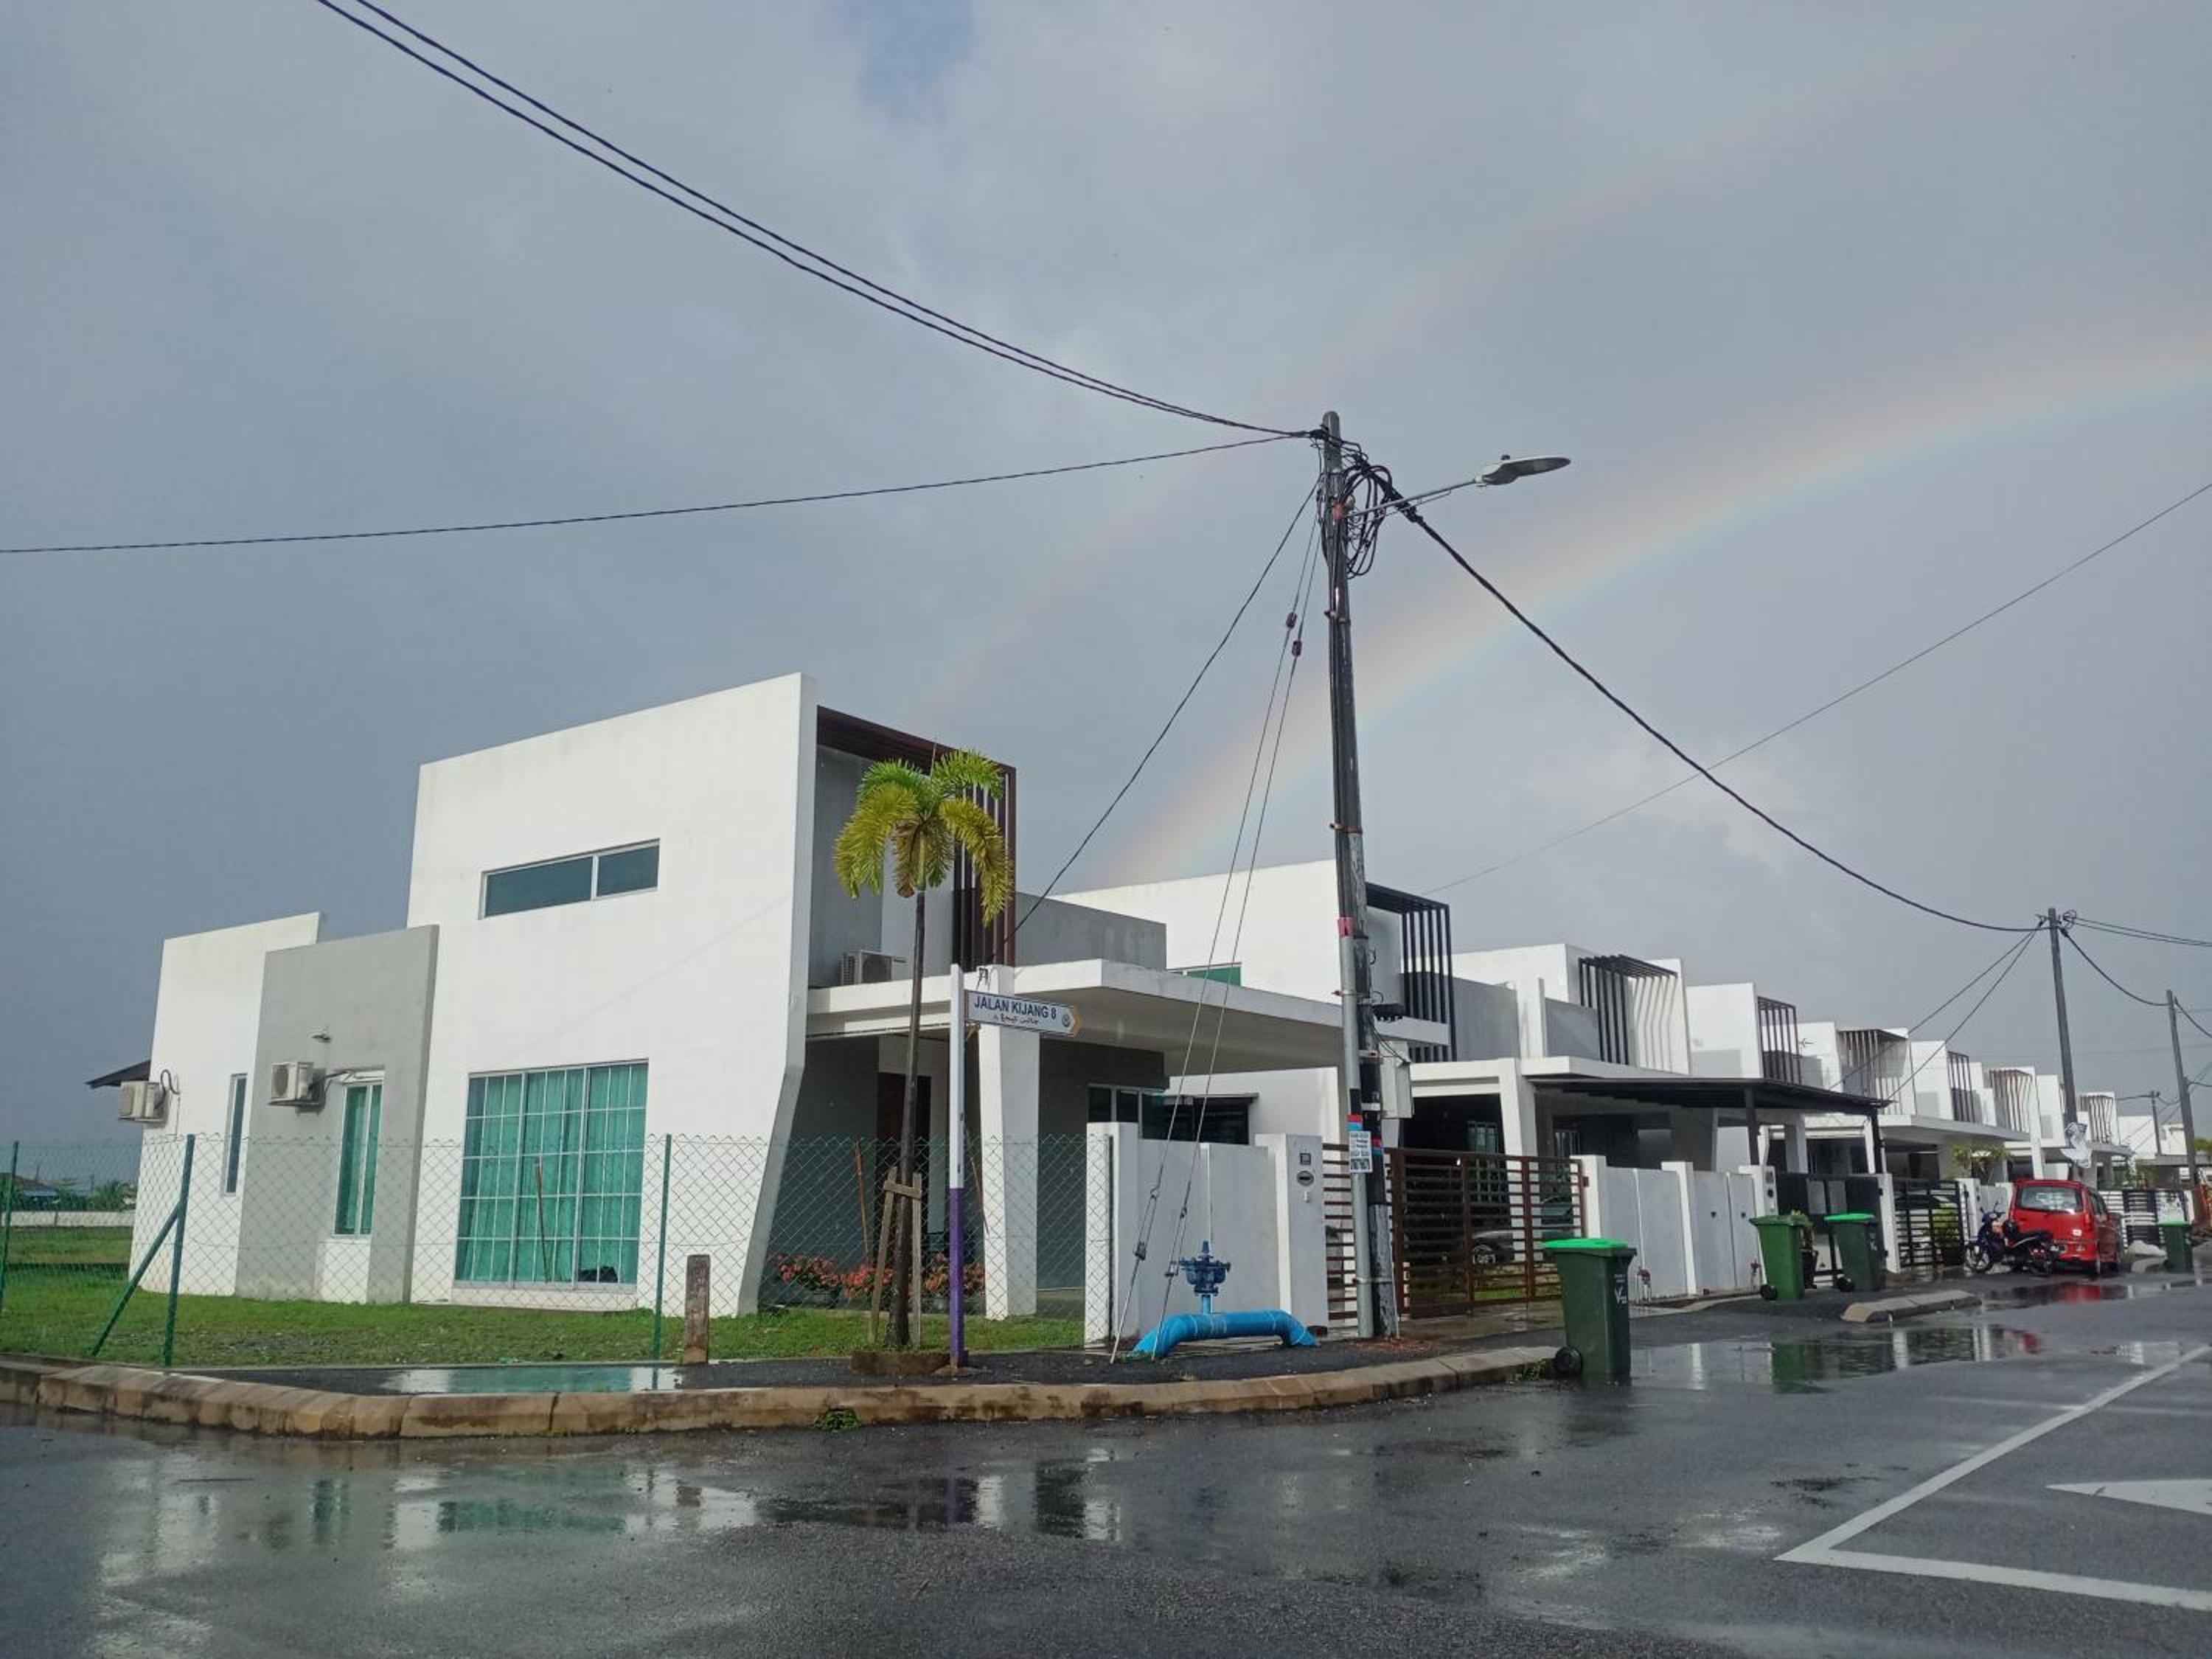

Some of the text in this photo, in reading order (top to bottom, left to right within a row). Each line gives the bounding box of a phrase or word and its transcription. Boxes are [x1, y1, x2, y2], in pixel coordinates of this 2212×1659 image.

[975, 995, 1057, 1019] JALAN KIJANG 8
